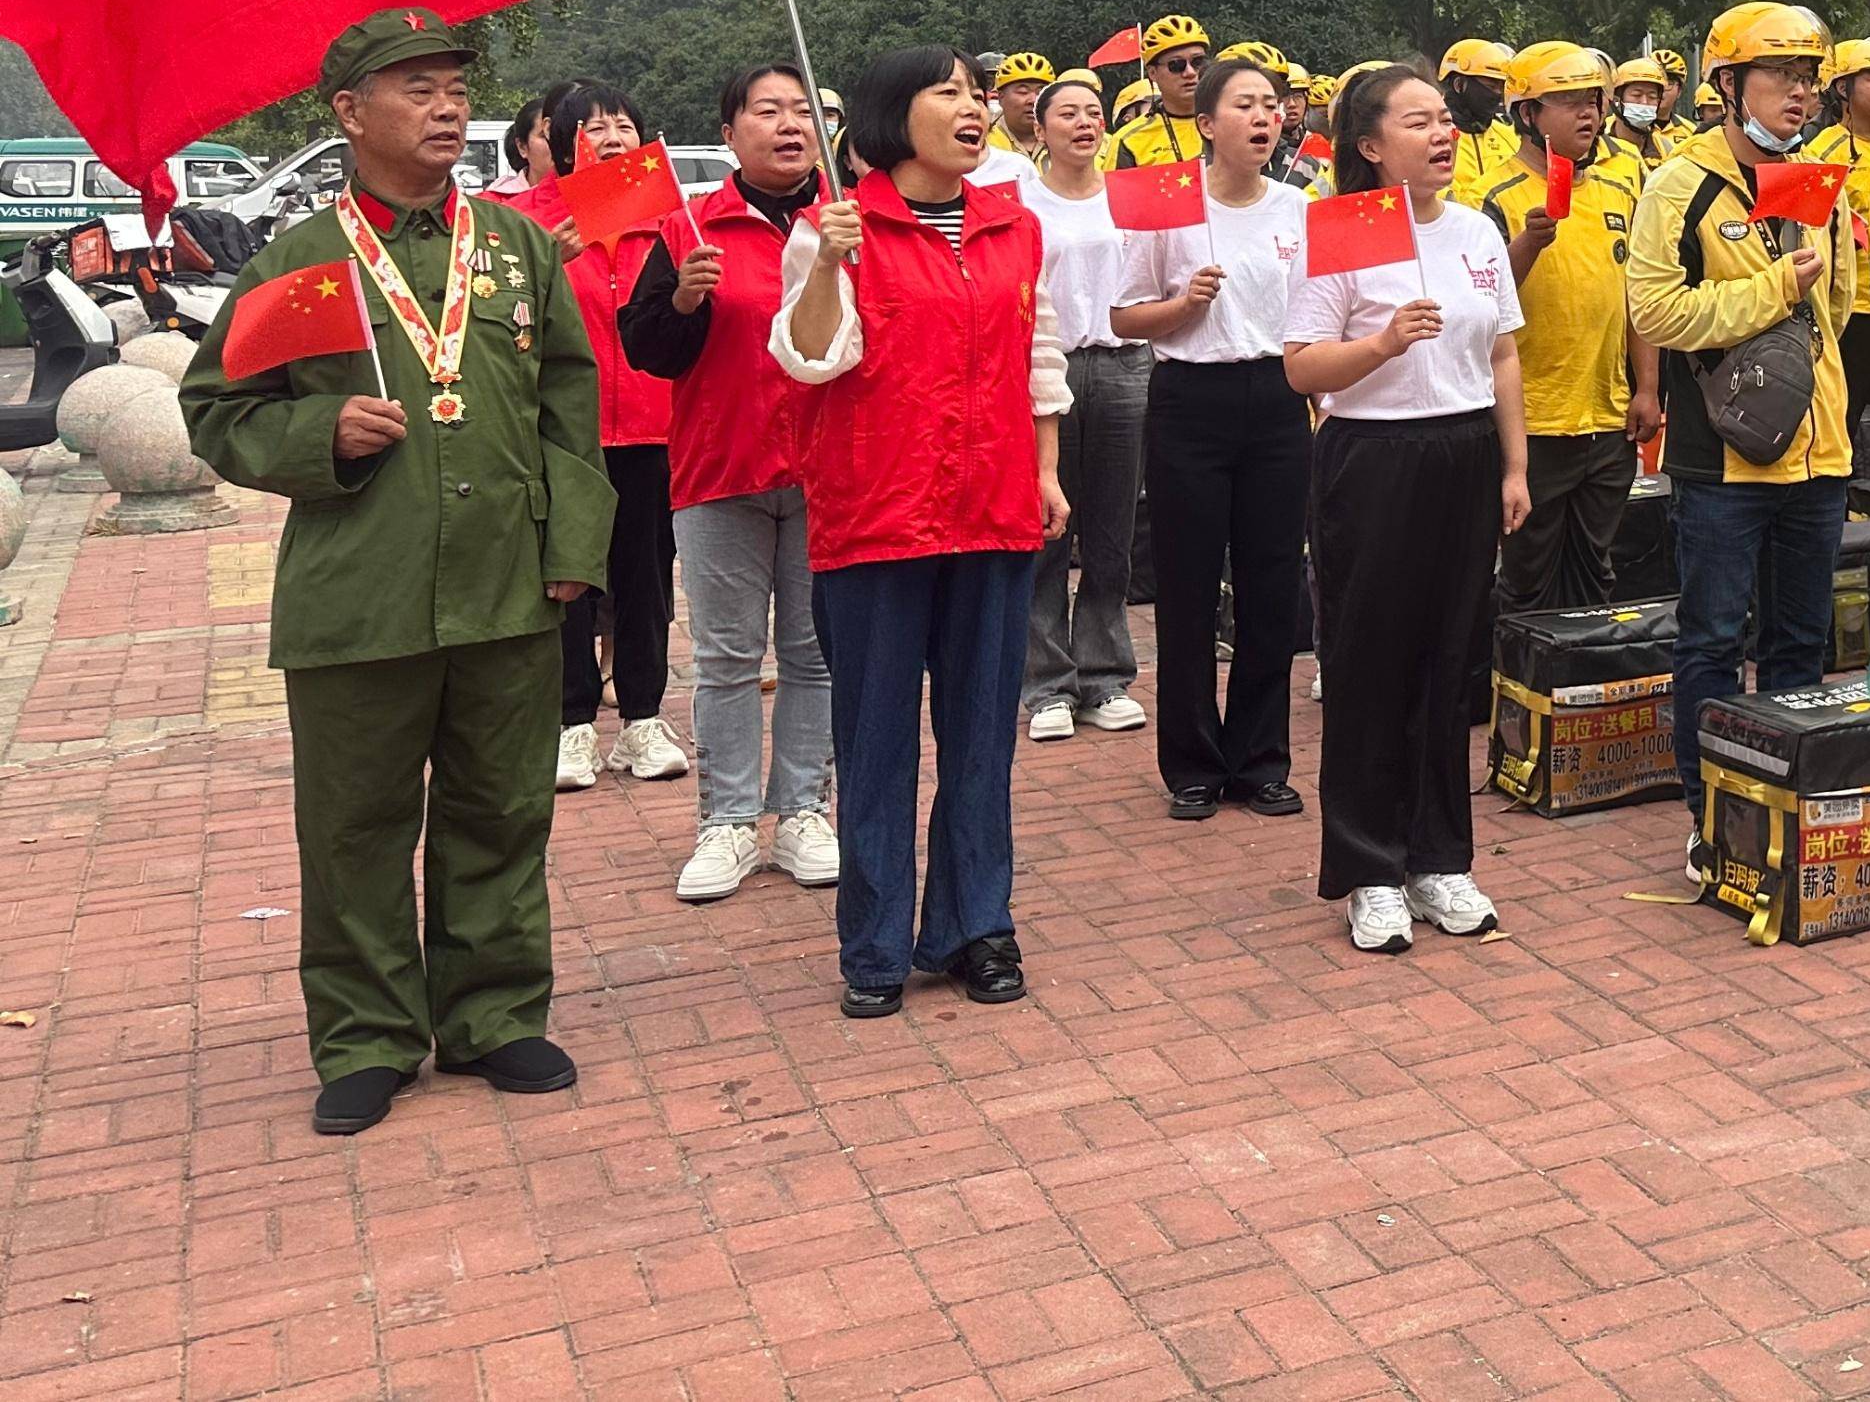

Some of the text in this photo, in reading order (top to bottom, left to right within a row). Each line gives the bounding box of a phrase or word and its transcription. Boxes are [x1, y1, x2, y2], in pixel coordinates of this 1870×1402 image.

[0, 207, 55, 218] VASEN
[1553, 706, 1656, 742] 岗位:送餐员
[1725, 858, 1766, 894] 扫码报
